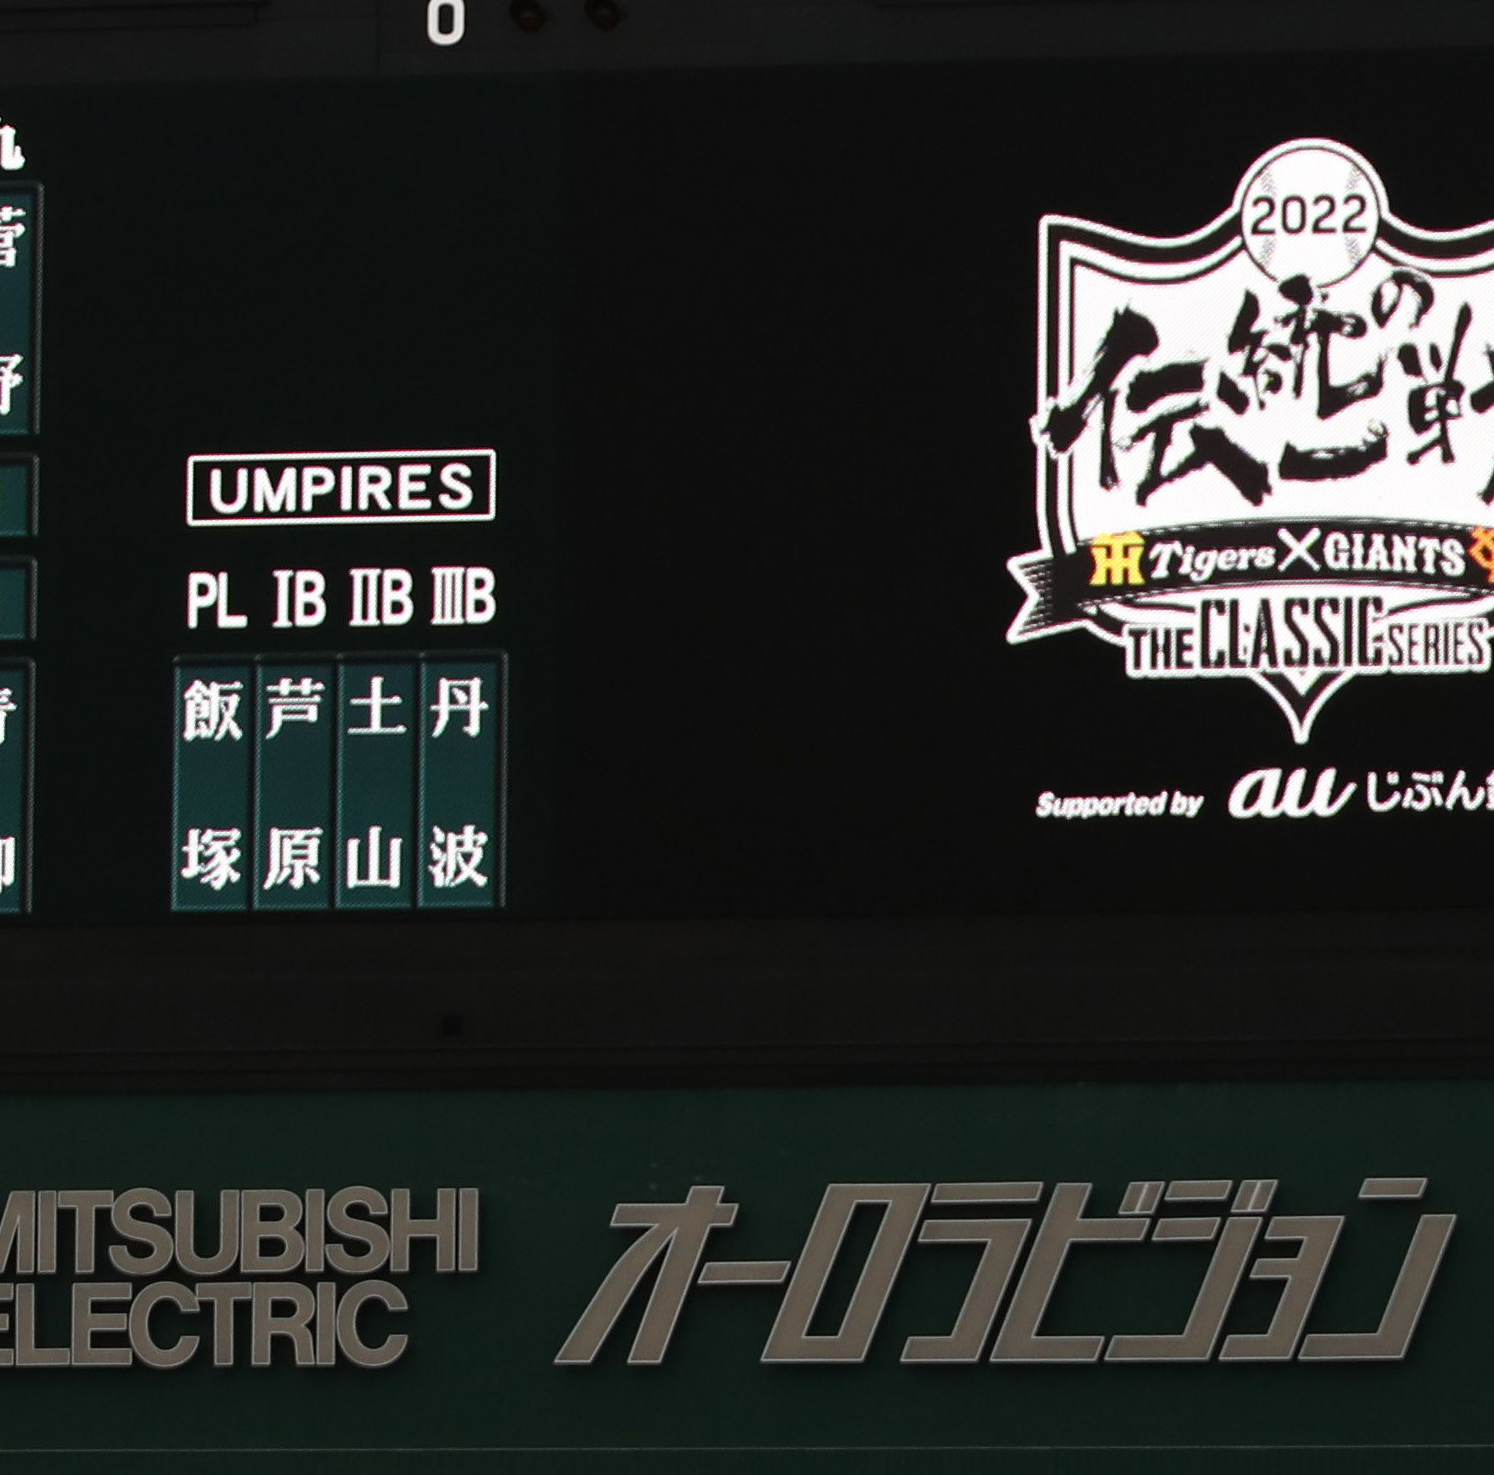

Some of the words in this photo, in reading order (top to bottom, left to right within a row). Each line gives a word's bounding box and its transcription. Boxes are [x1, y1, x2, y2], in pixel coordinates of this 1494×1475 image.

[1248, 191, 1370, 238] 2022
[208, 463, 474, 514] UMPIRES
[1148, 538, 1277, 582] Tigers
[1323, 535, 1466, 576] GIANTS
[189, 572, 247, 628] PL
[1130, 624, 1194, 671] THE
[1198, 597, 1387, 669] CLASSIC
[1387, 620, 1490, 666] SERIES
[182, 680, 243, 890] 飯塚
[264, 678, 325, 889] 芦原
[347, 677, 406, 888] 土山
[429, 677, 488, 887] 丹波
[1036, 791, 1166, 819] Supported
[1170, 791, 1204, 817] by
[1228, 768, 1357, 818] au
[552, 1176, 1459, 1366] オーロラビジョン
